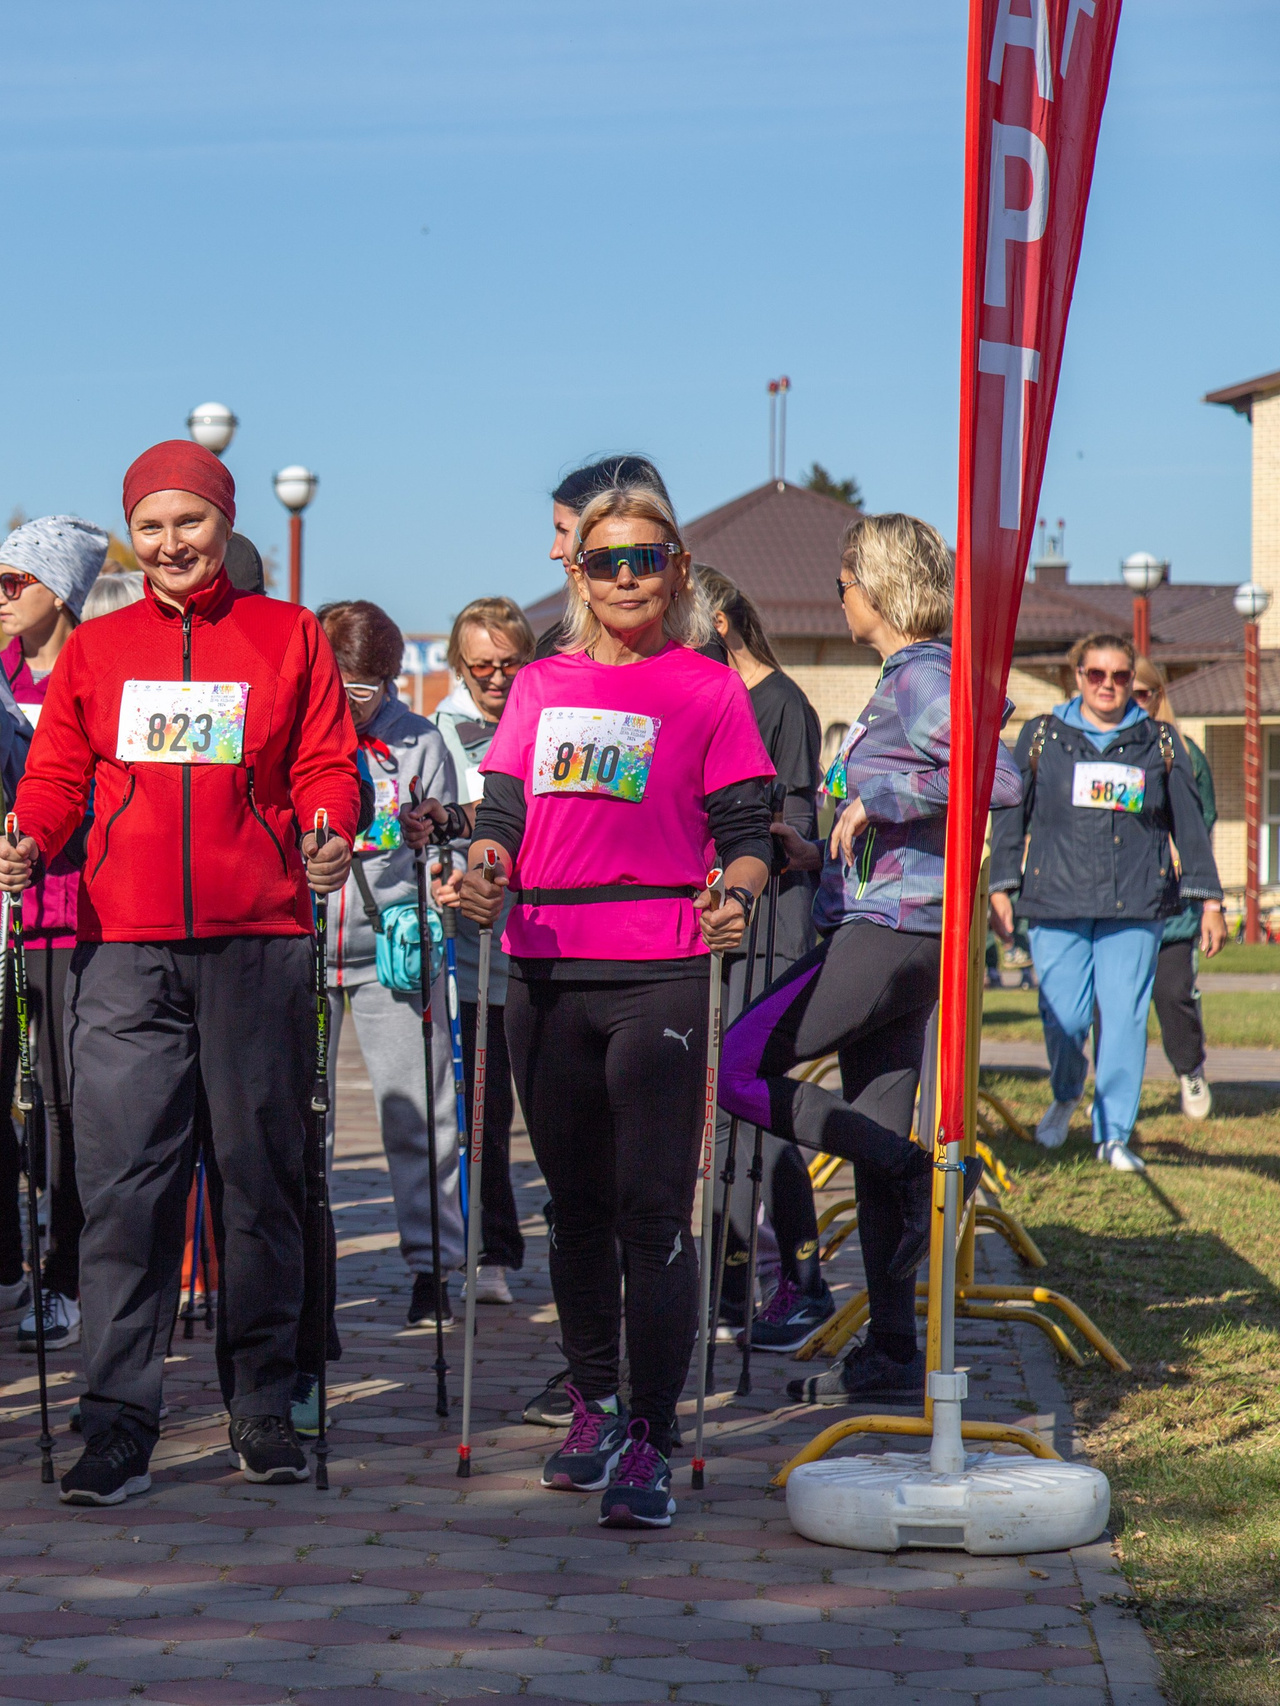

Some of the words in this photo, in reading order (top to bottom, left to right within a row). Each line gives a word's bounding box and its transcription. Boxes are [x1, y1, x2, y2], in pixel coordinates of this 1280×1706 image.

[147, 713, 213, 752] 823
[553, 742, 621, 784] 810
[1090, 780, 1127, 805] 582
[472, 1048, 487, 1163] PASSION
